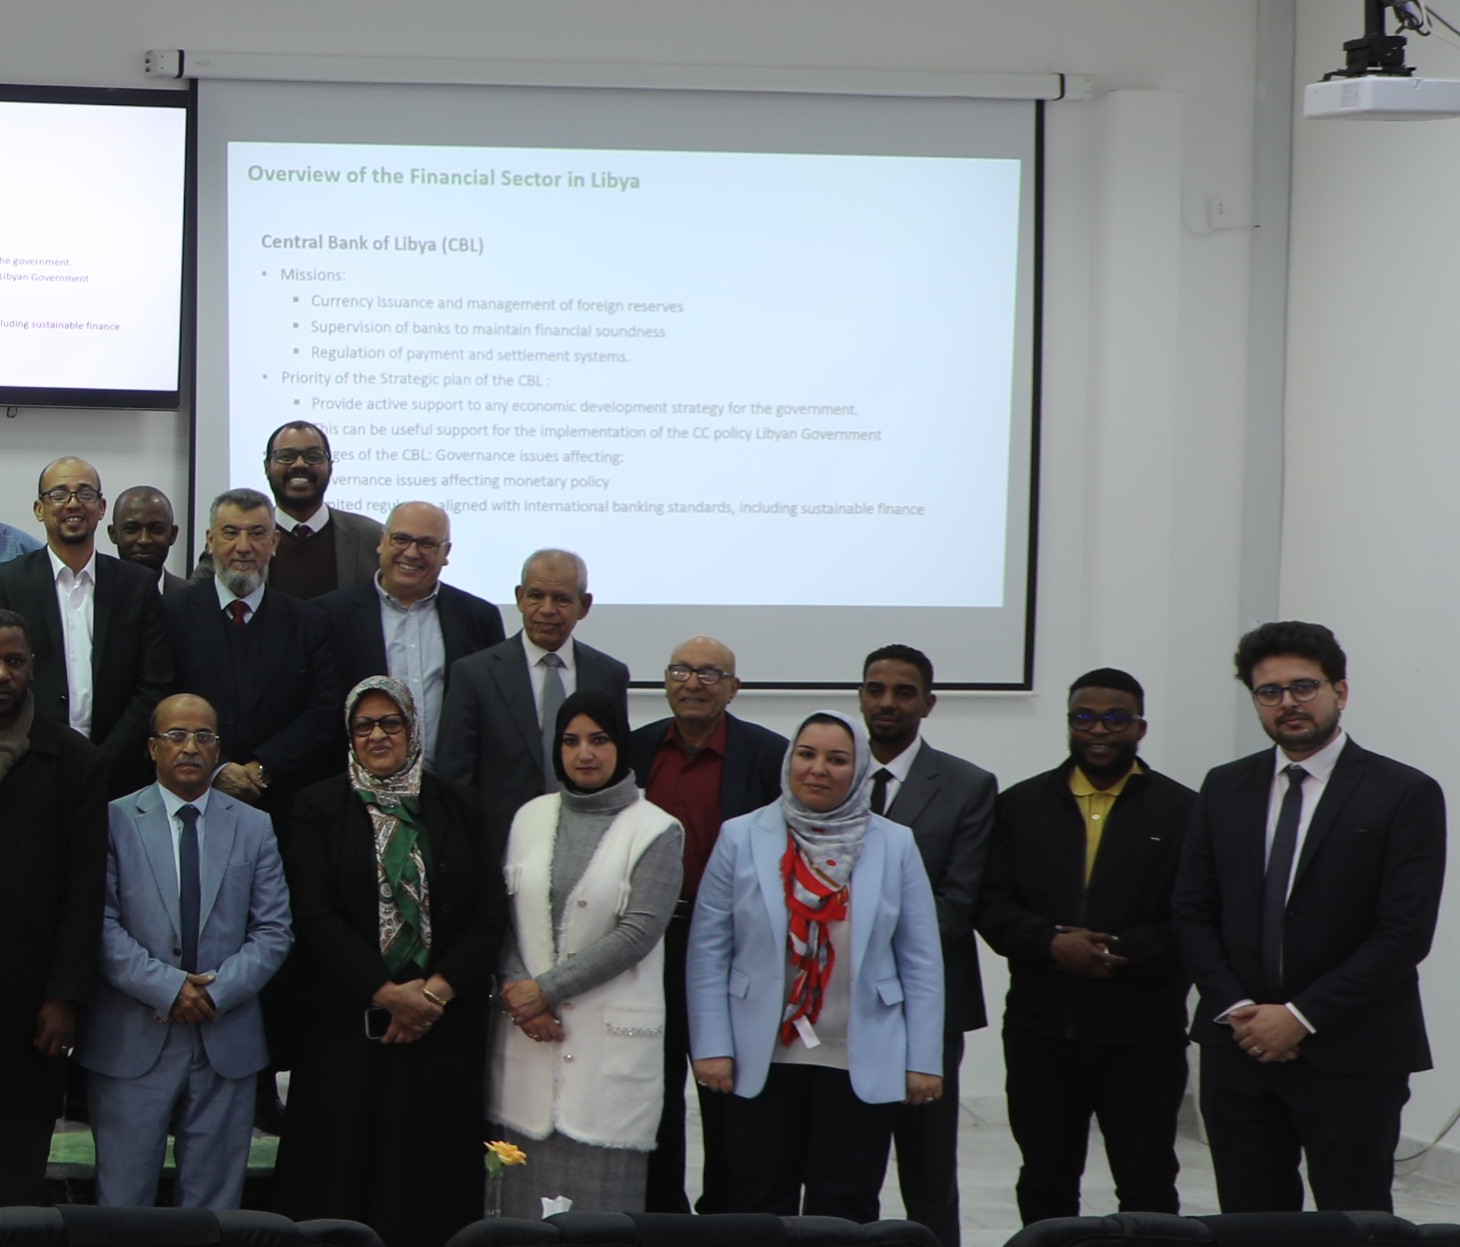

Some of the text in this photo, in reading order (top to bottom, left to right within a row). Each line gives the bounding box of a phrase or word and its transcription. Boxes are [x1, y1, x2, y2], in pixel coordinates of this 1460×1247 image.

[247, 164, 640, 192] Overview of the Financial Sector in Libya
[260, 232, 484, 256] Central Bank of Libya (CBL)
[310, 293, 374, 310] Currency
[437, 295, 463, 310] and
[466, 298, 556, 313] management
[558, 297, 574, 311] of
[576, 298, 624, 315] foreign
[627, 302, 684, 313] reserves
[30, 320, 84, 329] sustainable
[85, 321, 120, 330] finance
[310, 320, 666, 338] Supervision of banks to maintain financial soundness
[310, 346, 386, 361] Regulation
[388, 346, 403, 360] of
[406, 348, 464, 363] payment
[467, 347, 493, 361] and
[496, 348, 570, 362] settlement
[280, 371, 332, 387] Priority
[334, 371, 349, 384] of
[352, 371, 376, 385] the
[379, 371, 439, 388] Strategic
[442, 372, 471, 388] plan
[474, 372, 489, 386] of
[491, 373, 514, 386] the
[517, 374, 542, 387] CBL
[311, 395, 363, 410] Provide
[366, 395, 408, 410] active
[410, 398, 464, 414] support
[466, 399, 481, 411] to
[484, 400, 509, 414] any
[511, 399, 576, 412] economic
[578, 399, 667, 416] development
[670, 402, 725, 417] strategy
[727, 401, 747, 414] for
[749, 401, 772, 414] the
[341, 425, 366, 435] can
[368, 421, 387, 436] be
[390, 422, 433, 436] useful
[436, 424, 488, 440] support
[491, 423, 511, 436] for
[514, 424, 536, 436] the
[540, 424, 646, 440] implementation
[649, 425, 664, 438] of
[666, 426, 689, 438] the
[692, 426, 710, 439] CC
[712, 426, 753, 442] policy
[755, 426, 798, 442] Libyan
[800, 427, 882, 441] Government
[357, 447, 372, 460] of
[374, 447, 398, 461] the
[434, 448, 516, 461] Governance
[519, 449, 559, 462] issues
[396, 473, 437, 486] issues
[440, 473, 500, 489] affecting
[502, 475, 568, 490] monetary
[570, 475, 610, 490] policy
[490, 498, 520, 511] with
[523, 498, 609, 512] international
[611, 499, 665, 516] banking
[739, 500, 798, 517] including
[800, 501, 874, 514] sustainable
[876, 502, 925, 515] finance
